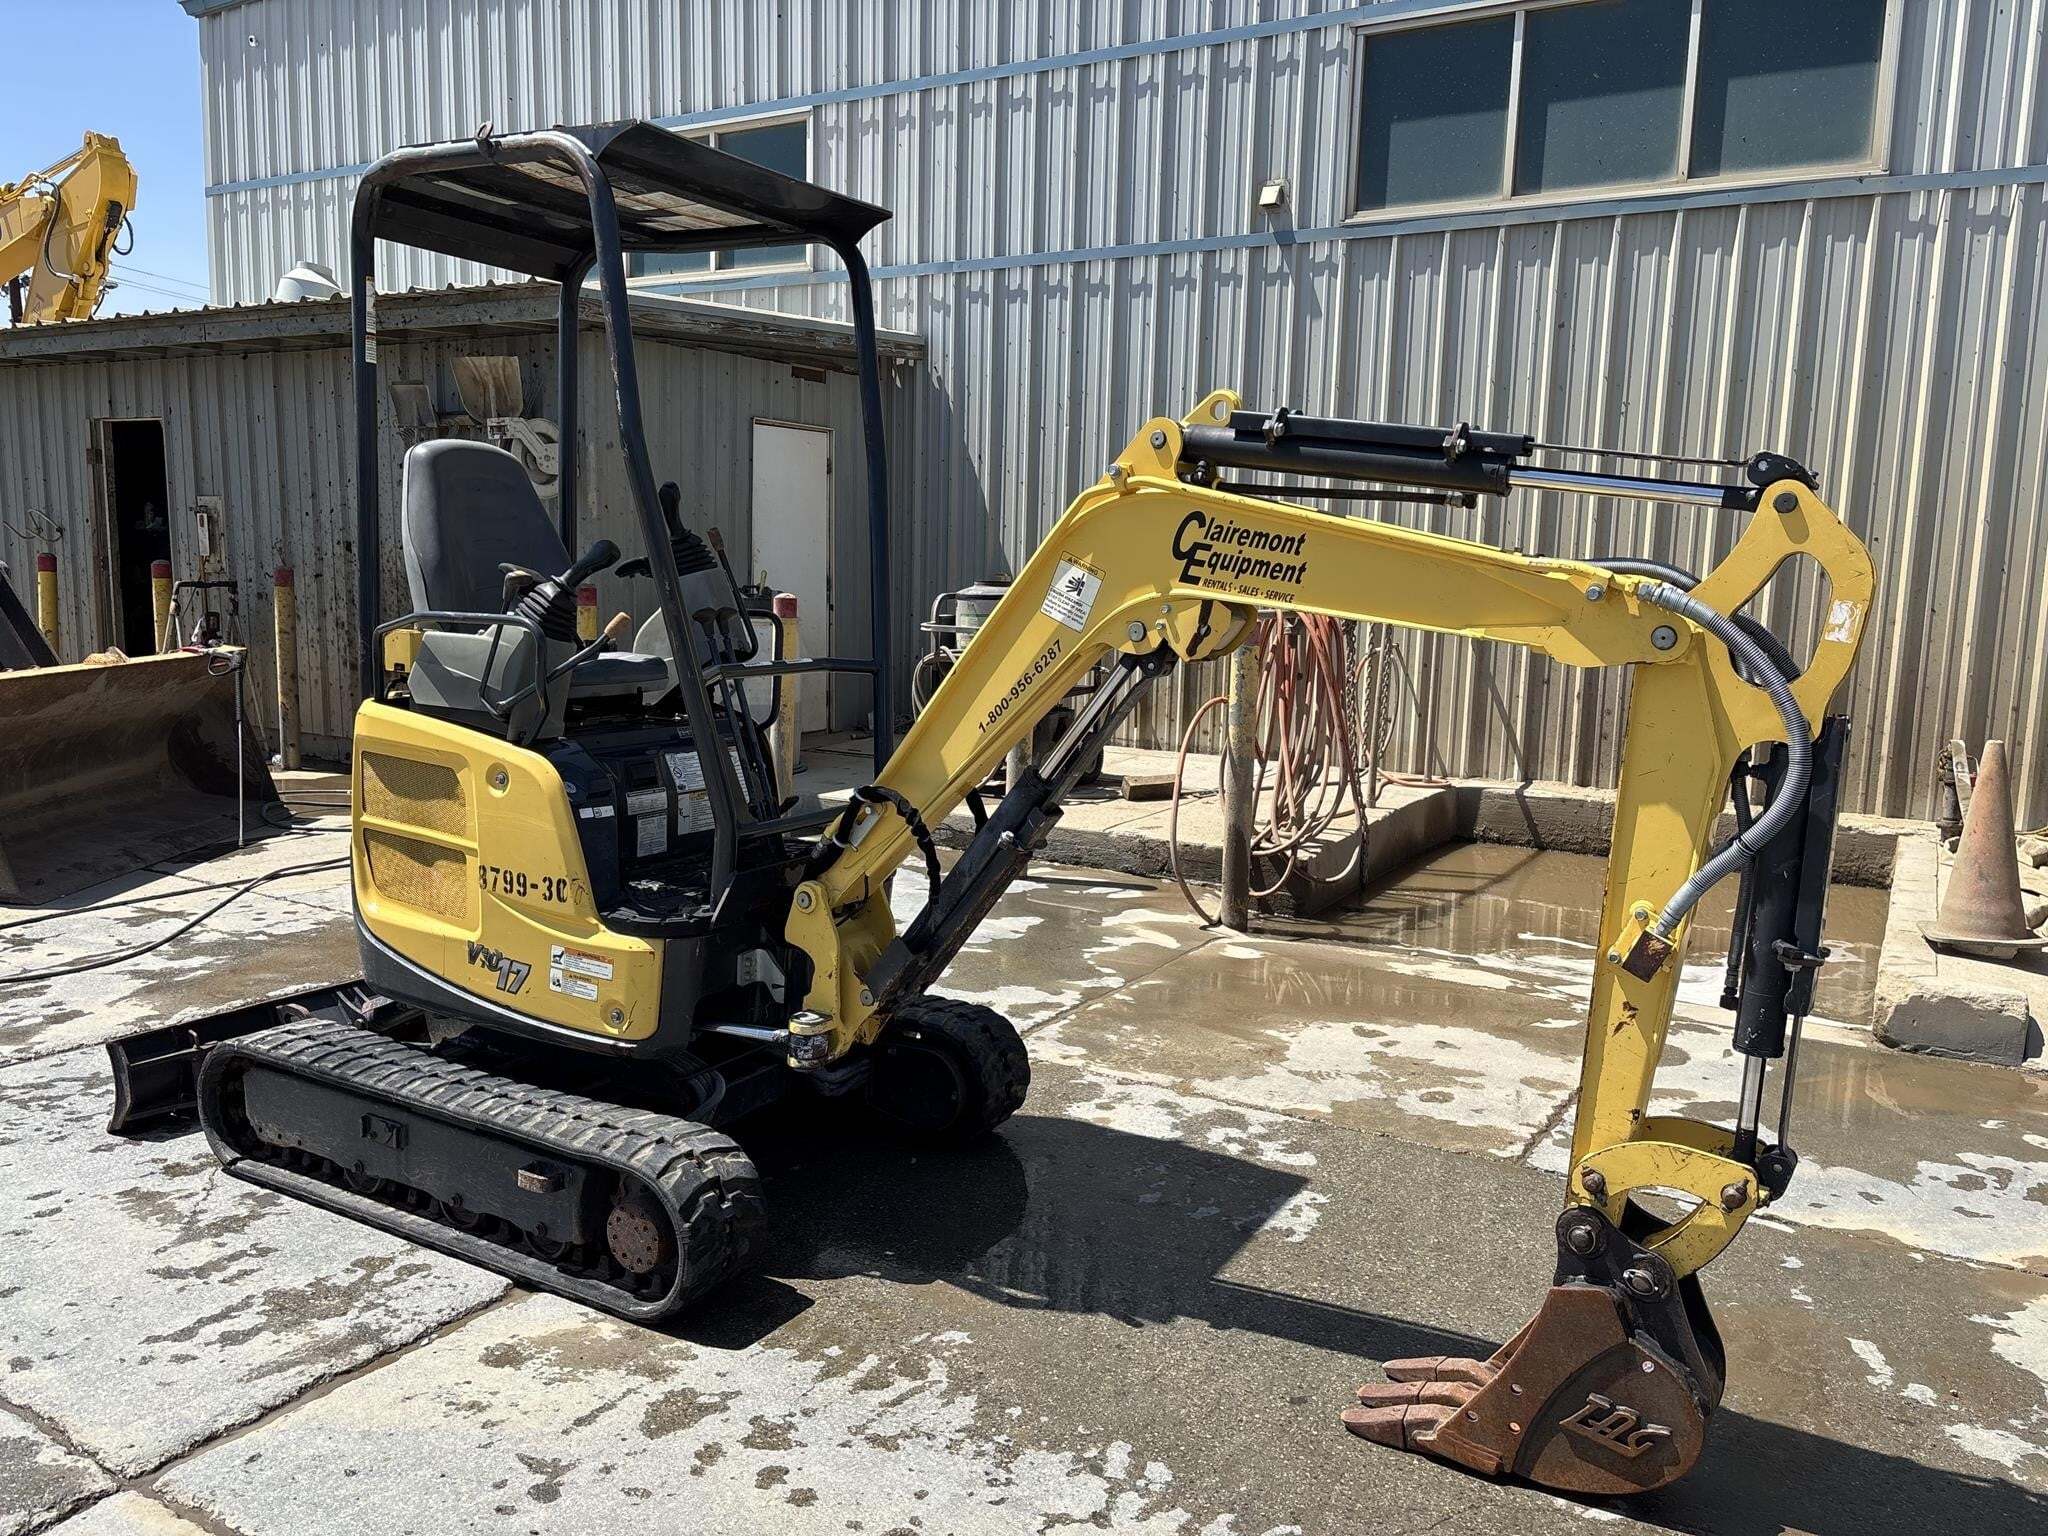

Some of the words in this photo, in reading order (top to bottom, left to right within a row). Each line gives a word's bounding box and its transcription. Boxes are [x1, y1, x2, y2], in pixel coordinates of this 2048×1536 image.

[1172, 511, 1307, 561] Clairemont
[1178, 542, 1308, 585] Equipment
[1202, 578, 1233, 593] RENTALS
[1238, 584, 1260, 597] SALES
[1264, 589, 1295, 603] SERVICE
[978, 638, 1062, 734] 1-800-956-6287
